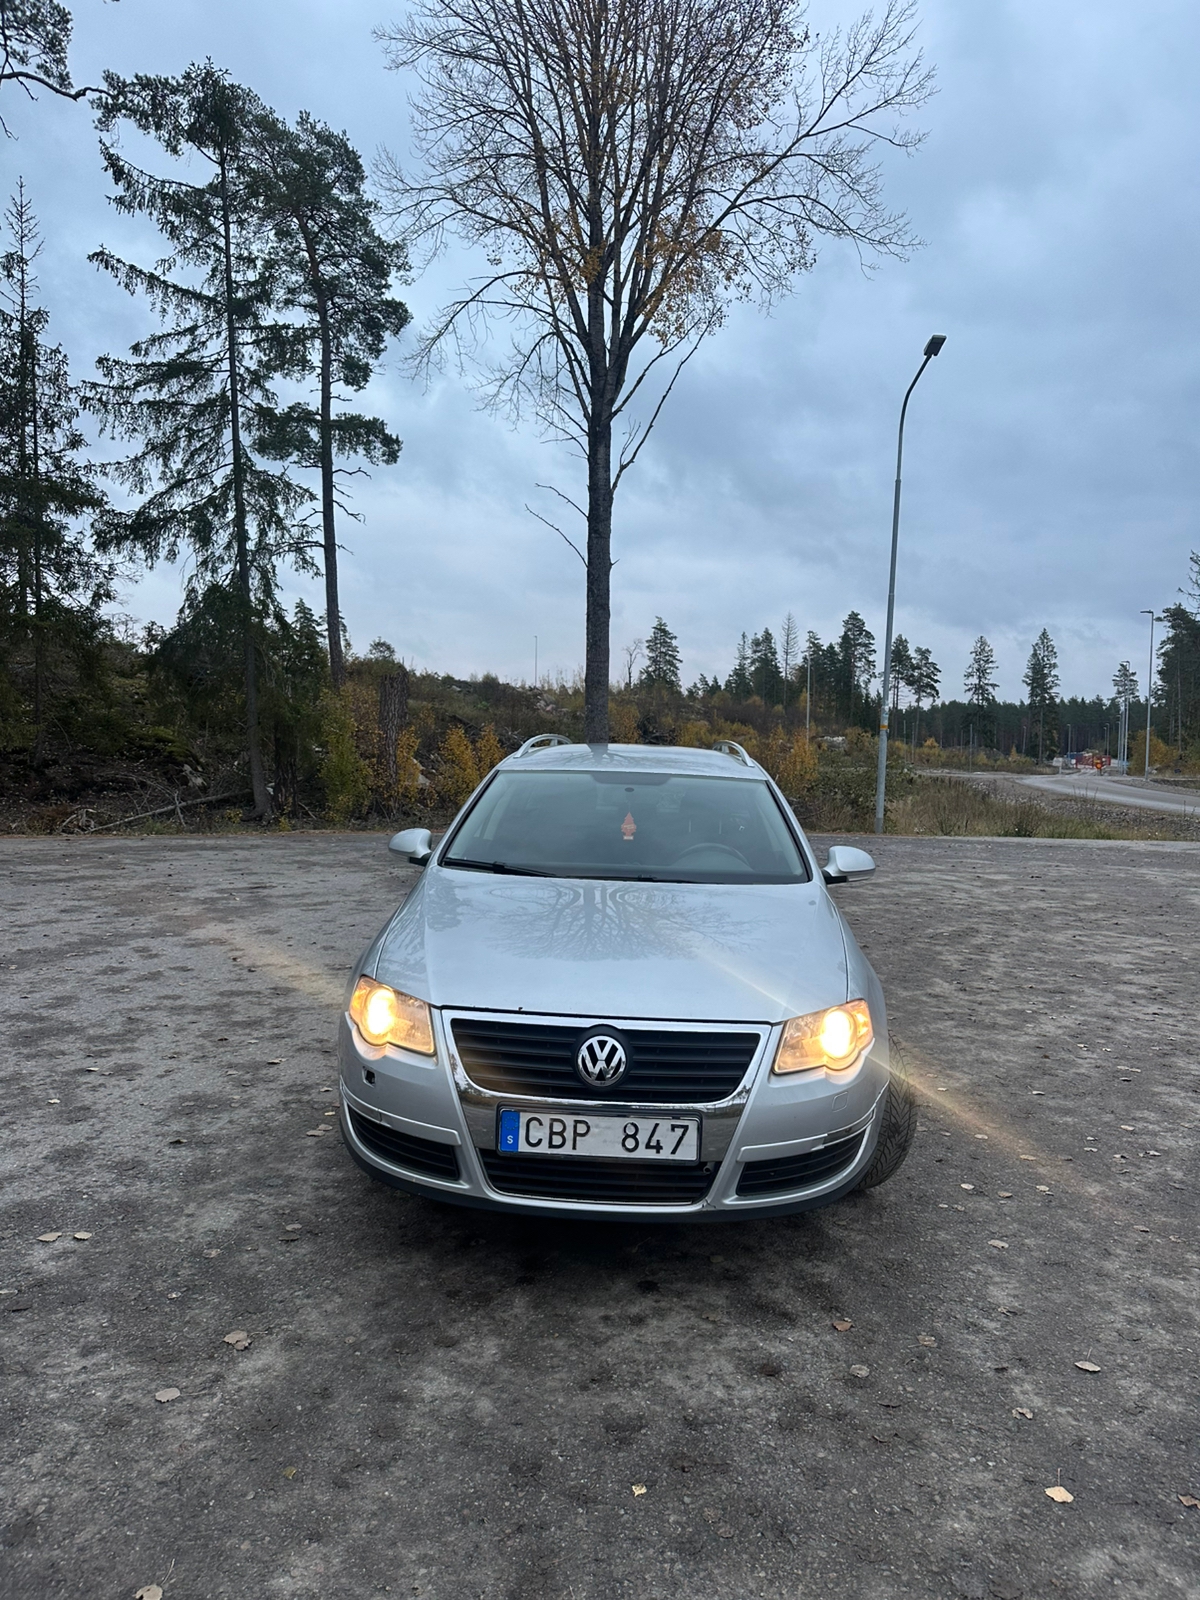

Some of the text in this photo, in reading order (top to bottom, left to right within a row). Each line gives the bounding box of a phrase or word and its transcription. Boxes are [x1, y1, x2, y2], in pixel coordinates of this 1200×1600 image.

[578, 1036, 626, 1086] VW
[506, 1134, 514, 1145] S
[525, 1116, 690, 1155] CBP 847
